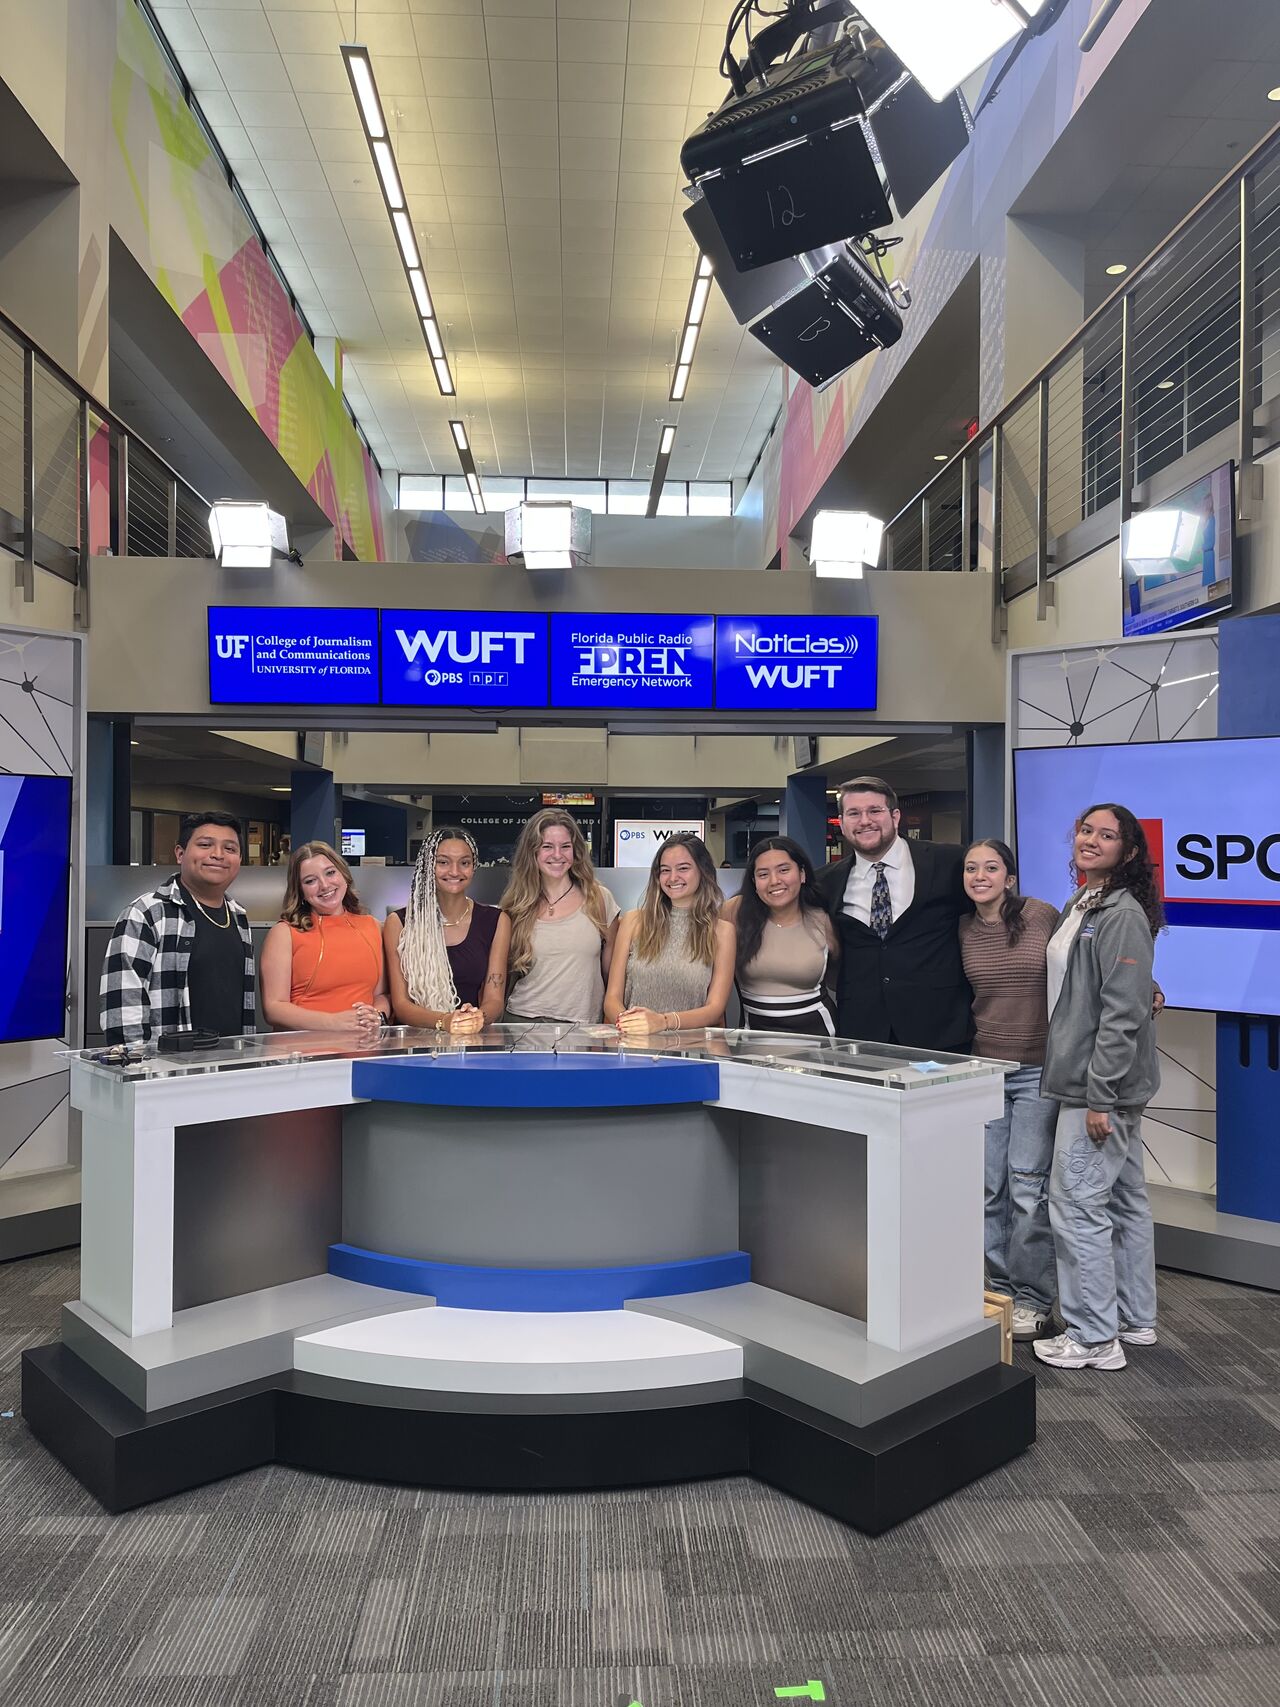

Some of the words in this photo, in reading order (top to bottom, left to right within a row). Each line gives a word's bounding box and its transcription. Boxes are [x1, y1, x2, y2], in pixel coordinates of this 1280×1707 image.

[766, 185, 807, 230] 12
[256, 635, 297, 649] College
[299, 635, 311, 646] of
[312, 636, 373, 648] Journalism
[571, 633, 613, 644] Florida
[617, 633, 655, 644] Public
[658, 634, 693, 645] Radio
[735, 633, 845, 654] Noticias
[215, 634, 250, 659] UF
[394, 629, 536, 664] WUFT
[256, 649, 276, 659] and
[279, 650, 371, 661] Communications
[256, 665, 316, 675] UNIVERSITY
[318, 666, 329, 676] of
[329, 666, 372, 675] FLORIDA
[744, 665, 843, 689] WUFT
[441, 672, 463, 684] PBS
[571, 676, 639, 689] Emergency
[641, 677, 693, 688] Network
[460, 817, 500, 825] COLLEGE
[630, 831, 646, 839] PBS
